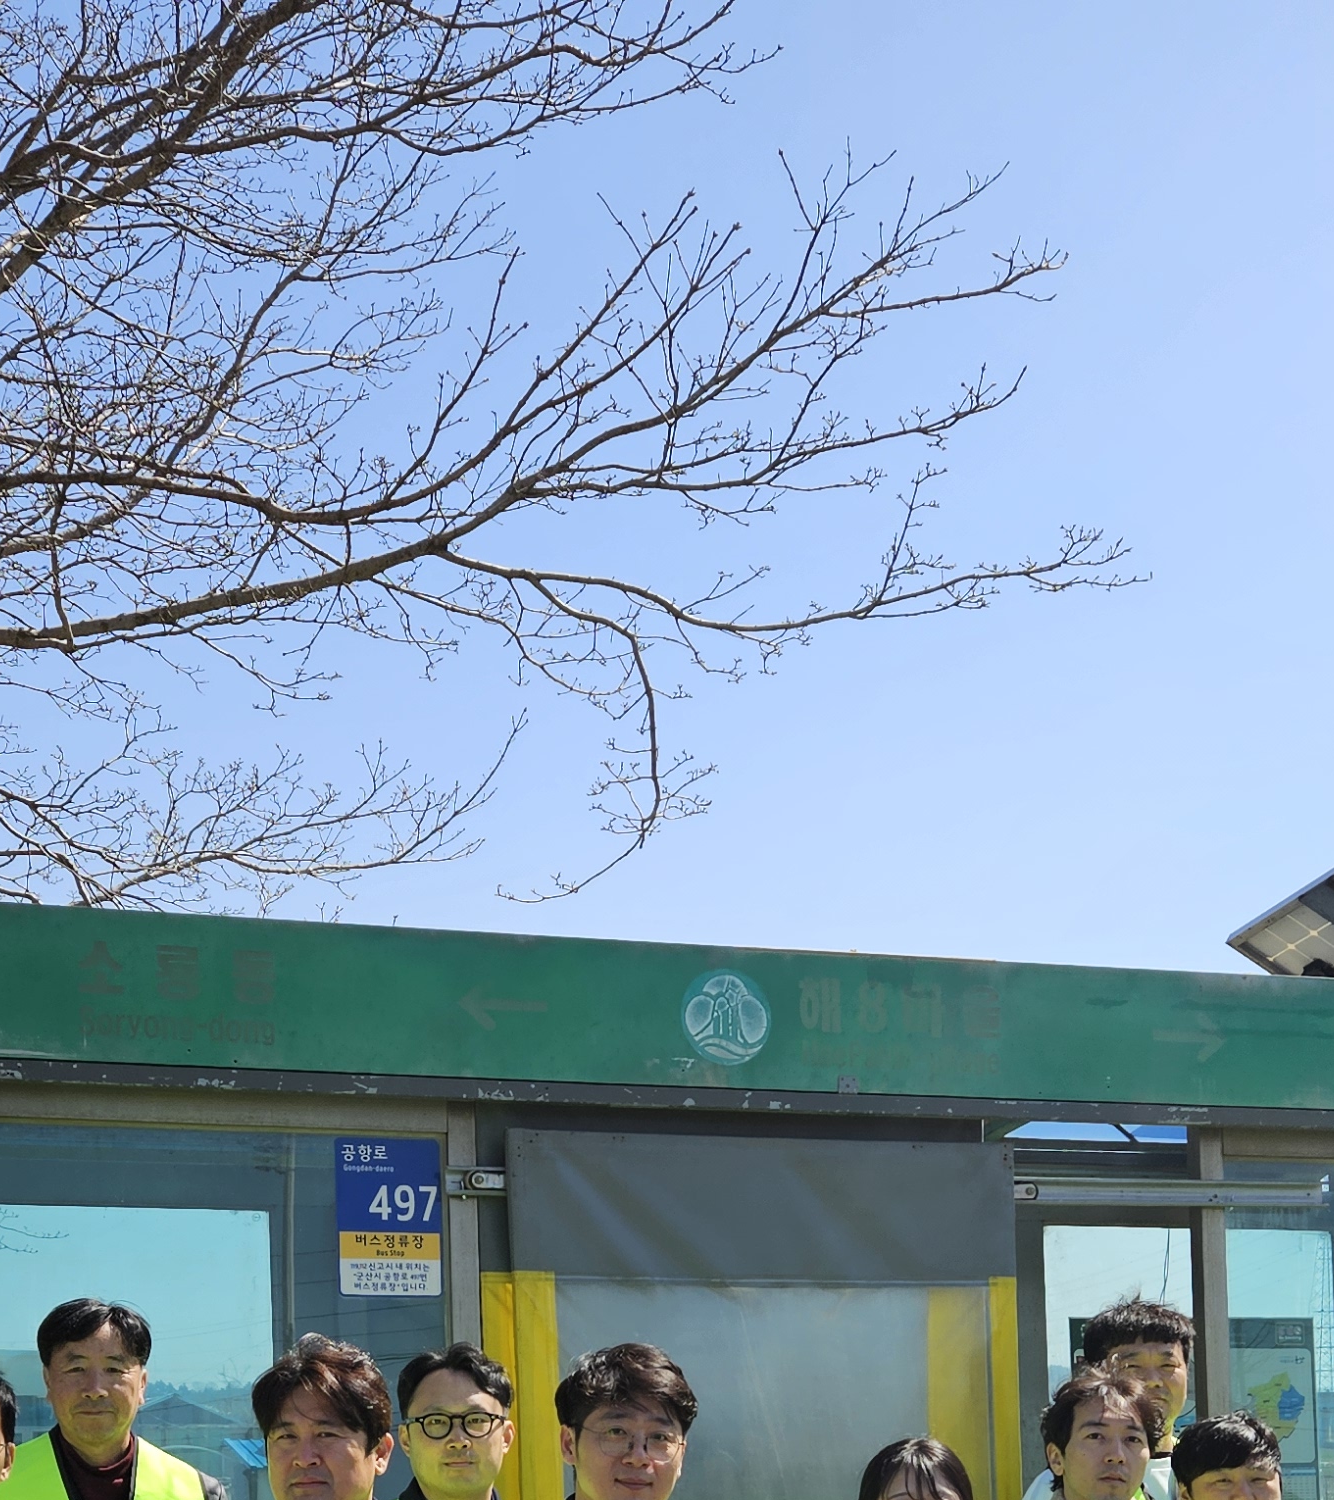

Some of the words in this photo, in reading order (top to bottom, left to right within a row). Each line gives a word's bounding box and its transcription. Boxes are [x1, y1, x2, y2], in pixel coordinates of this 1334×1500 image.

[341, 1144, 388, 1162] 공항로
[369, 1184, 437, 1221] 497
[355, 1234, 424, 1249] 버스정류장
